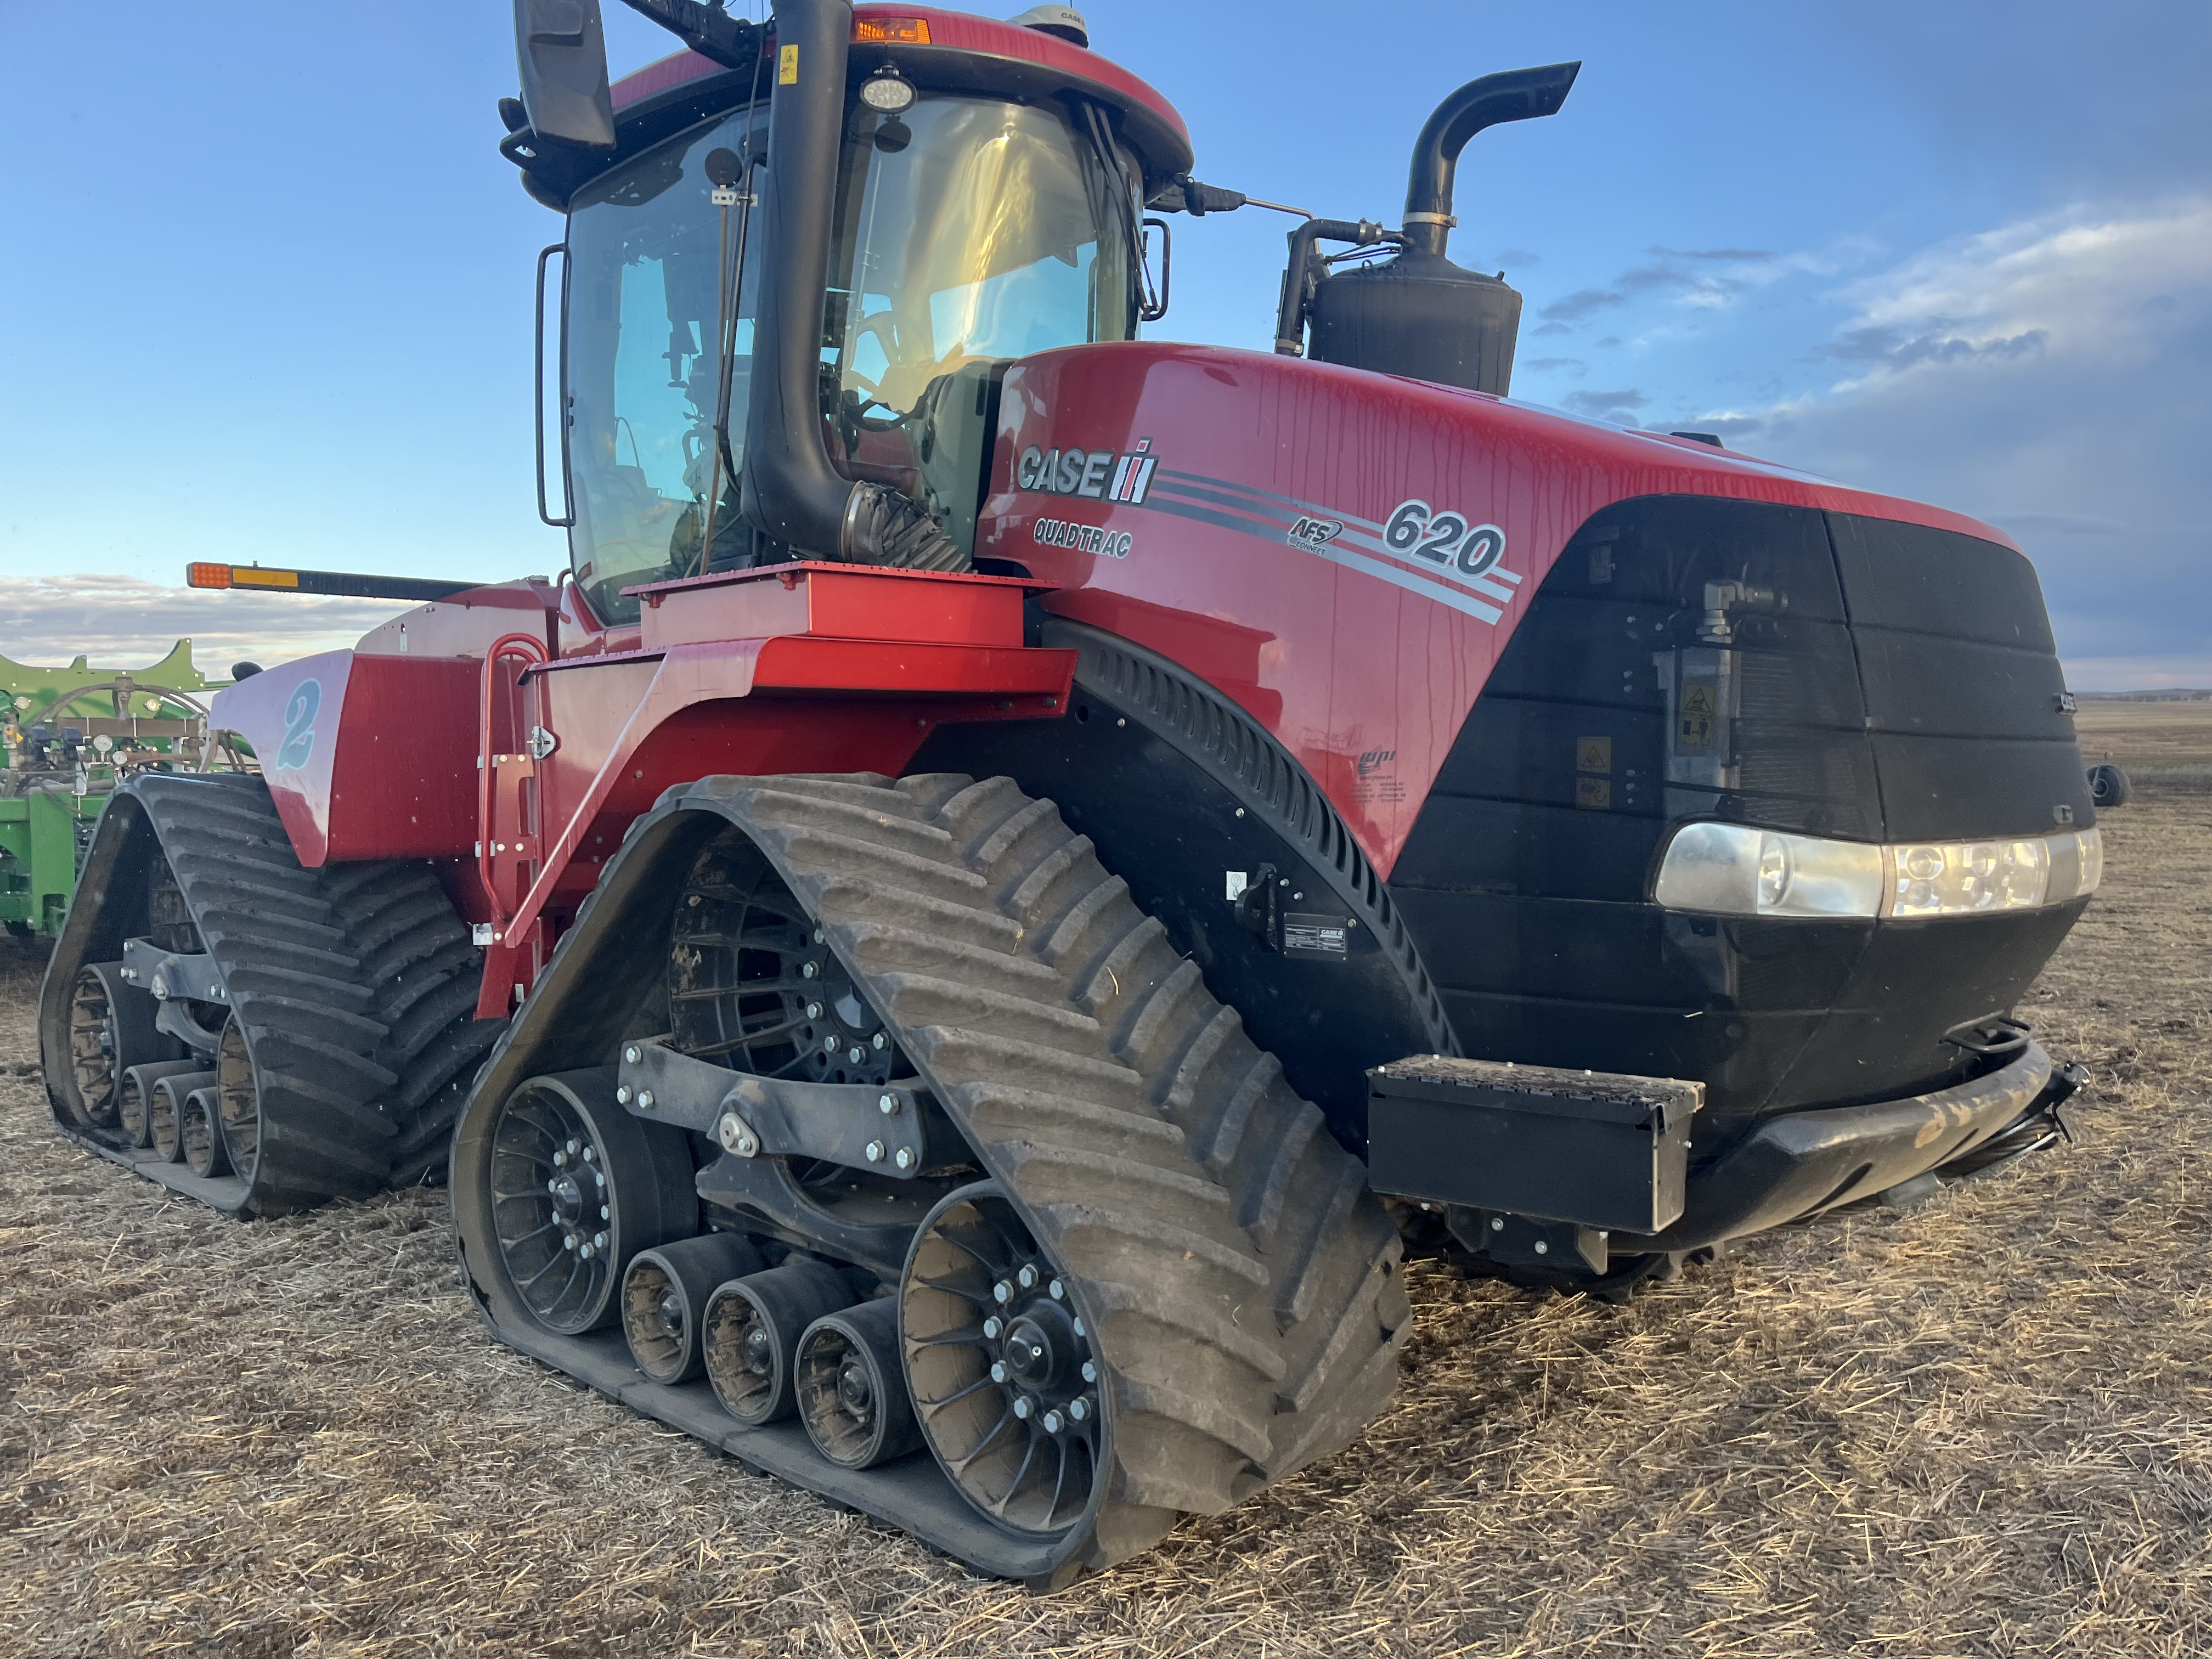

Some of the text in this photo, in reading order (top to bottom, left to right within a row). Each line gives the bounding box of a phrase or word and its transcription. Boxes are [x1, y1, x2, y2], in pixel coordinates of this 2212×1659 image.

[1018, 446, 1114, 498] CASE
[1034, 517, 1132, 559] QUADTRAC
[1289, 517, 1331, 543] AFS
[1296, 541, 1326, 555] CONNECT
[1383, 499, 1505, 579] 620
[276, 678, 321, 771] 2
